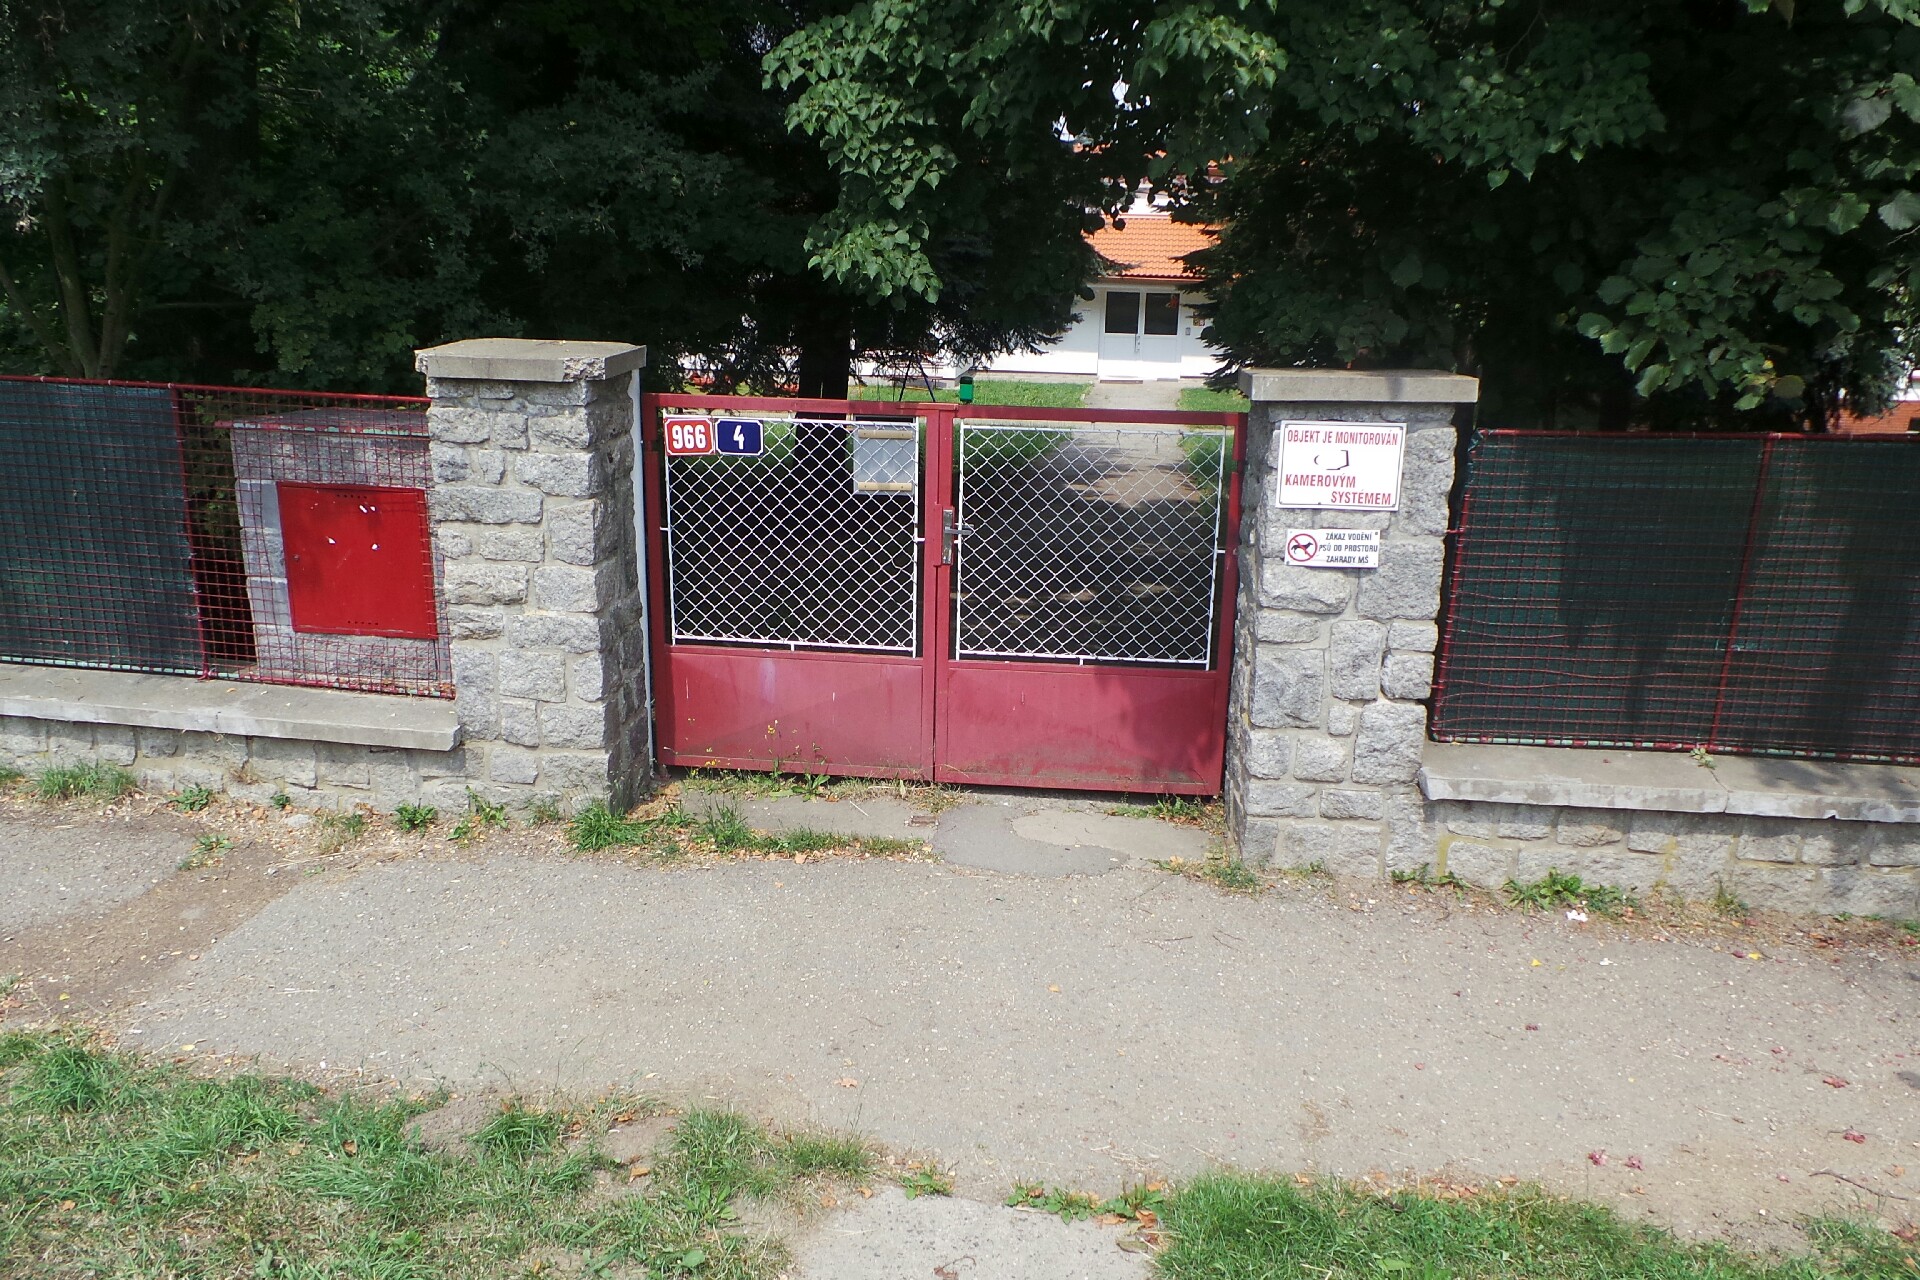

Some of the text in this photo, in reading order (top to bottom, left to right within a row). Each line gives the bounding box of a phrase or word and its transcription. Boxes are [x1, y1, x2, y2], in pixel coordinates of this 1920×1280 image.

[672, 425, 706, 449] 966
[733, 425, 745, 450] 4
[1287, 430, 1398, 446] OBJEKT JE MONITOROVÁN
[1285, 473, 1356, 488] KAMEROVÝM
[1331, 489, 1392, 505] SYSTÉMEM
[1325, 531, 1372, 541] ZÁKAZ VODĚNÍ
[1318, 543, 1378, 552] PSŮ DO PROSTORU
[1326, 555, 1369, 564] ZAHRADY MŠ
